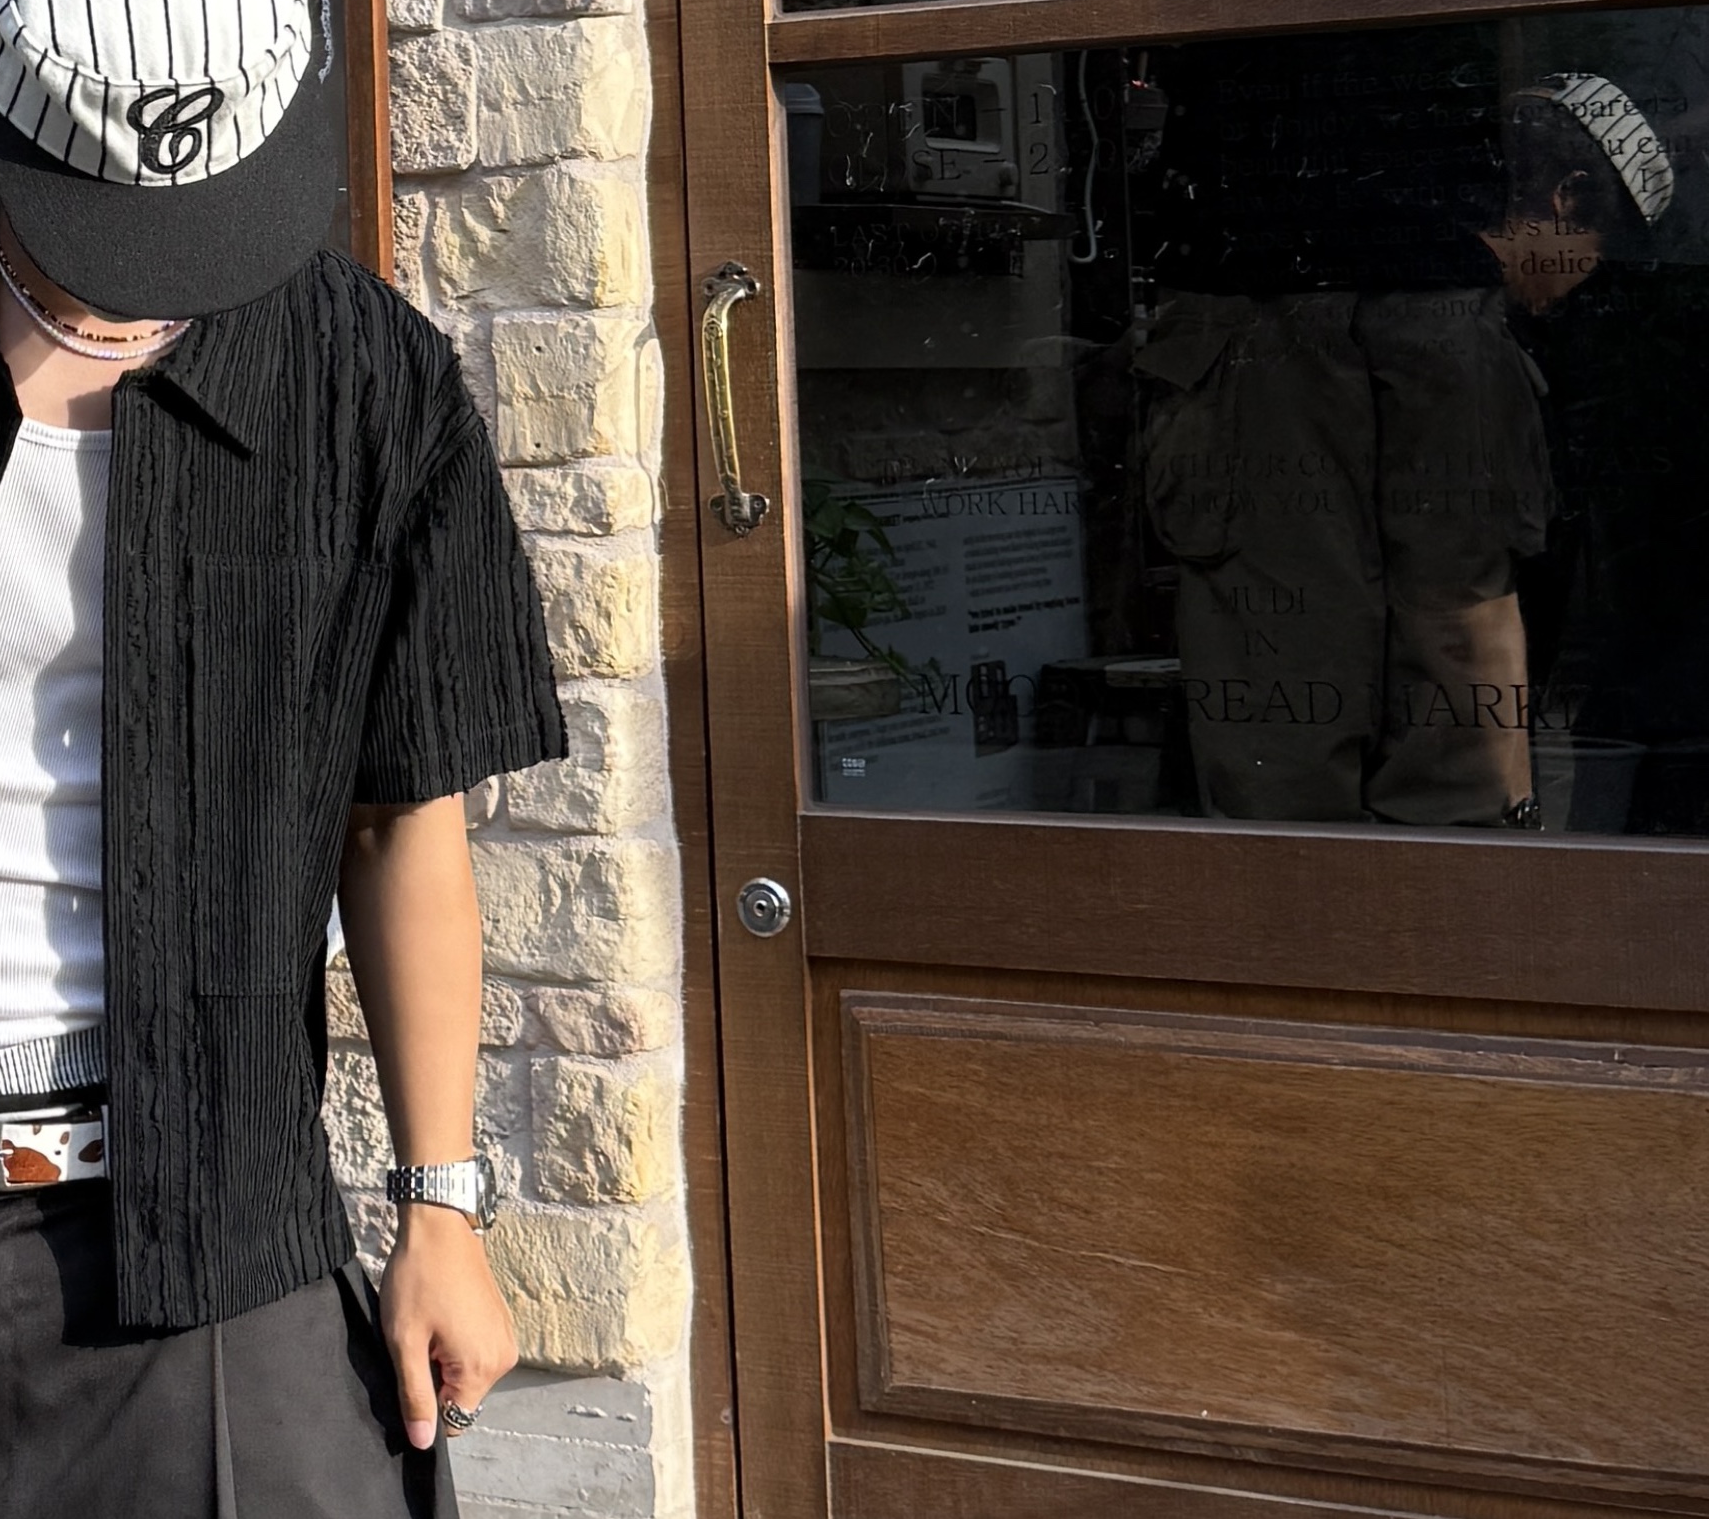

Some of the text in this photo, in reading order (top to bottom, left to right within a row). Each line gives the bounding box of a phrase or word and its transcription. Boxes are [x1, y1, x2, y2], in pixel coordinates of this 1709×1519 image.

[1216, 76, 1292, 105] Even
[1017, 489, 1082, 517] HAR
[1179, 678, 1344, 726] READ
